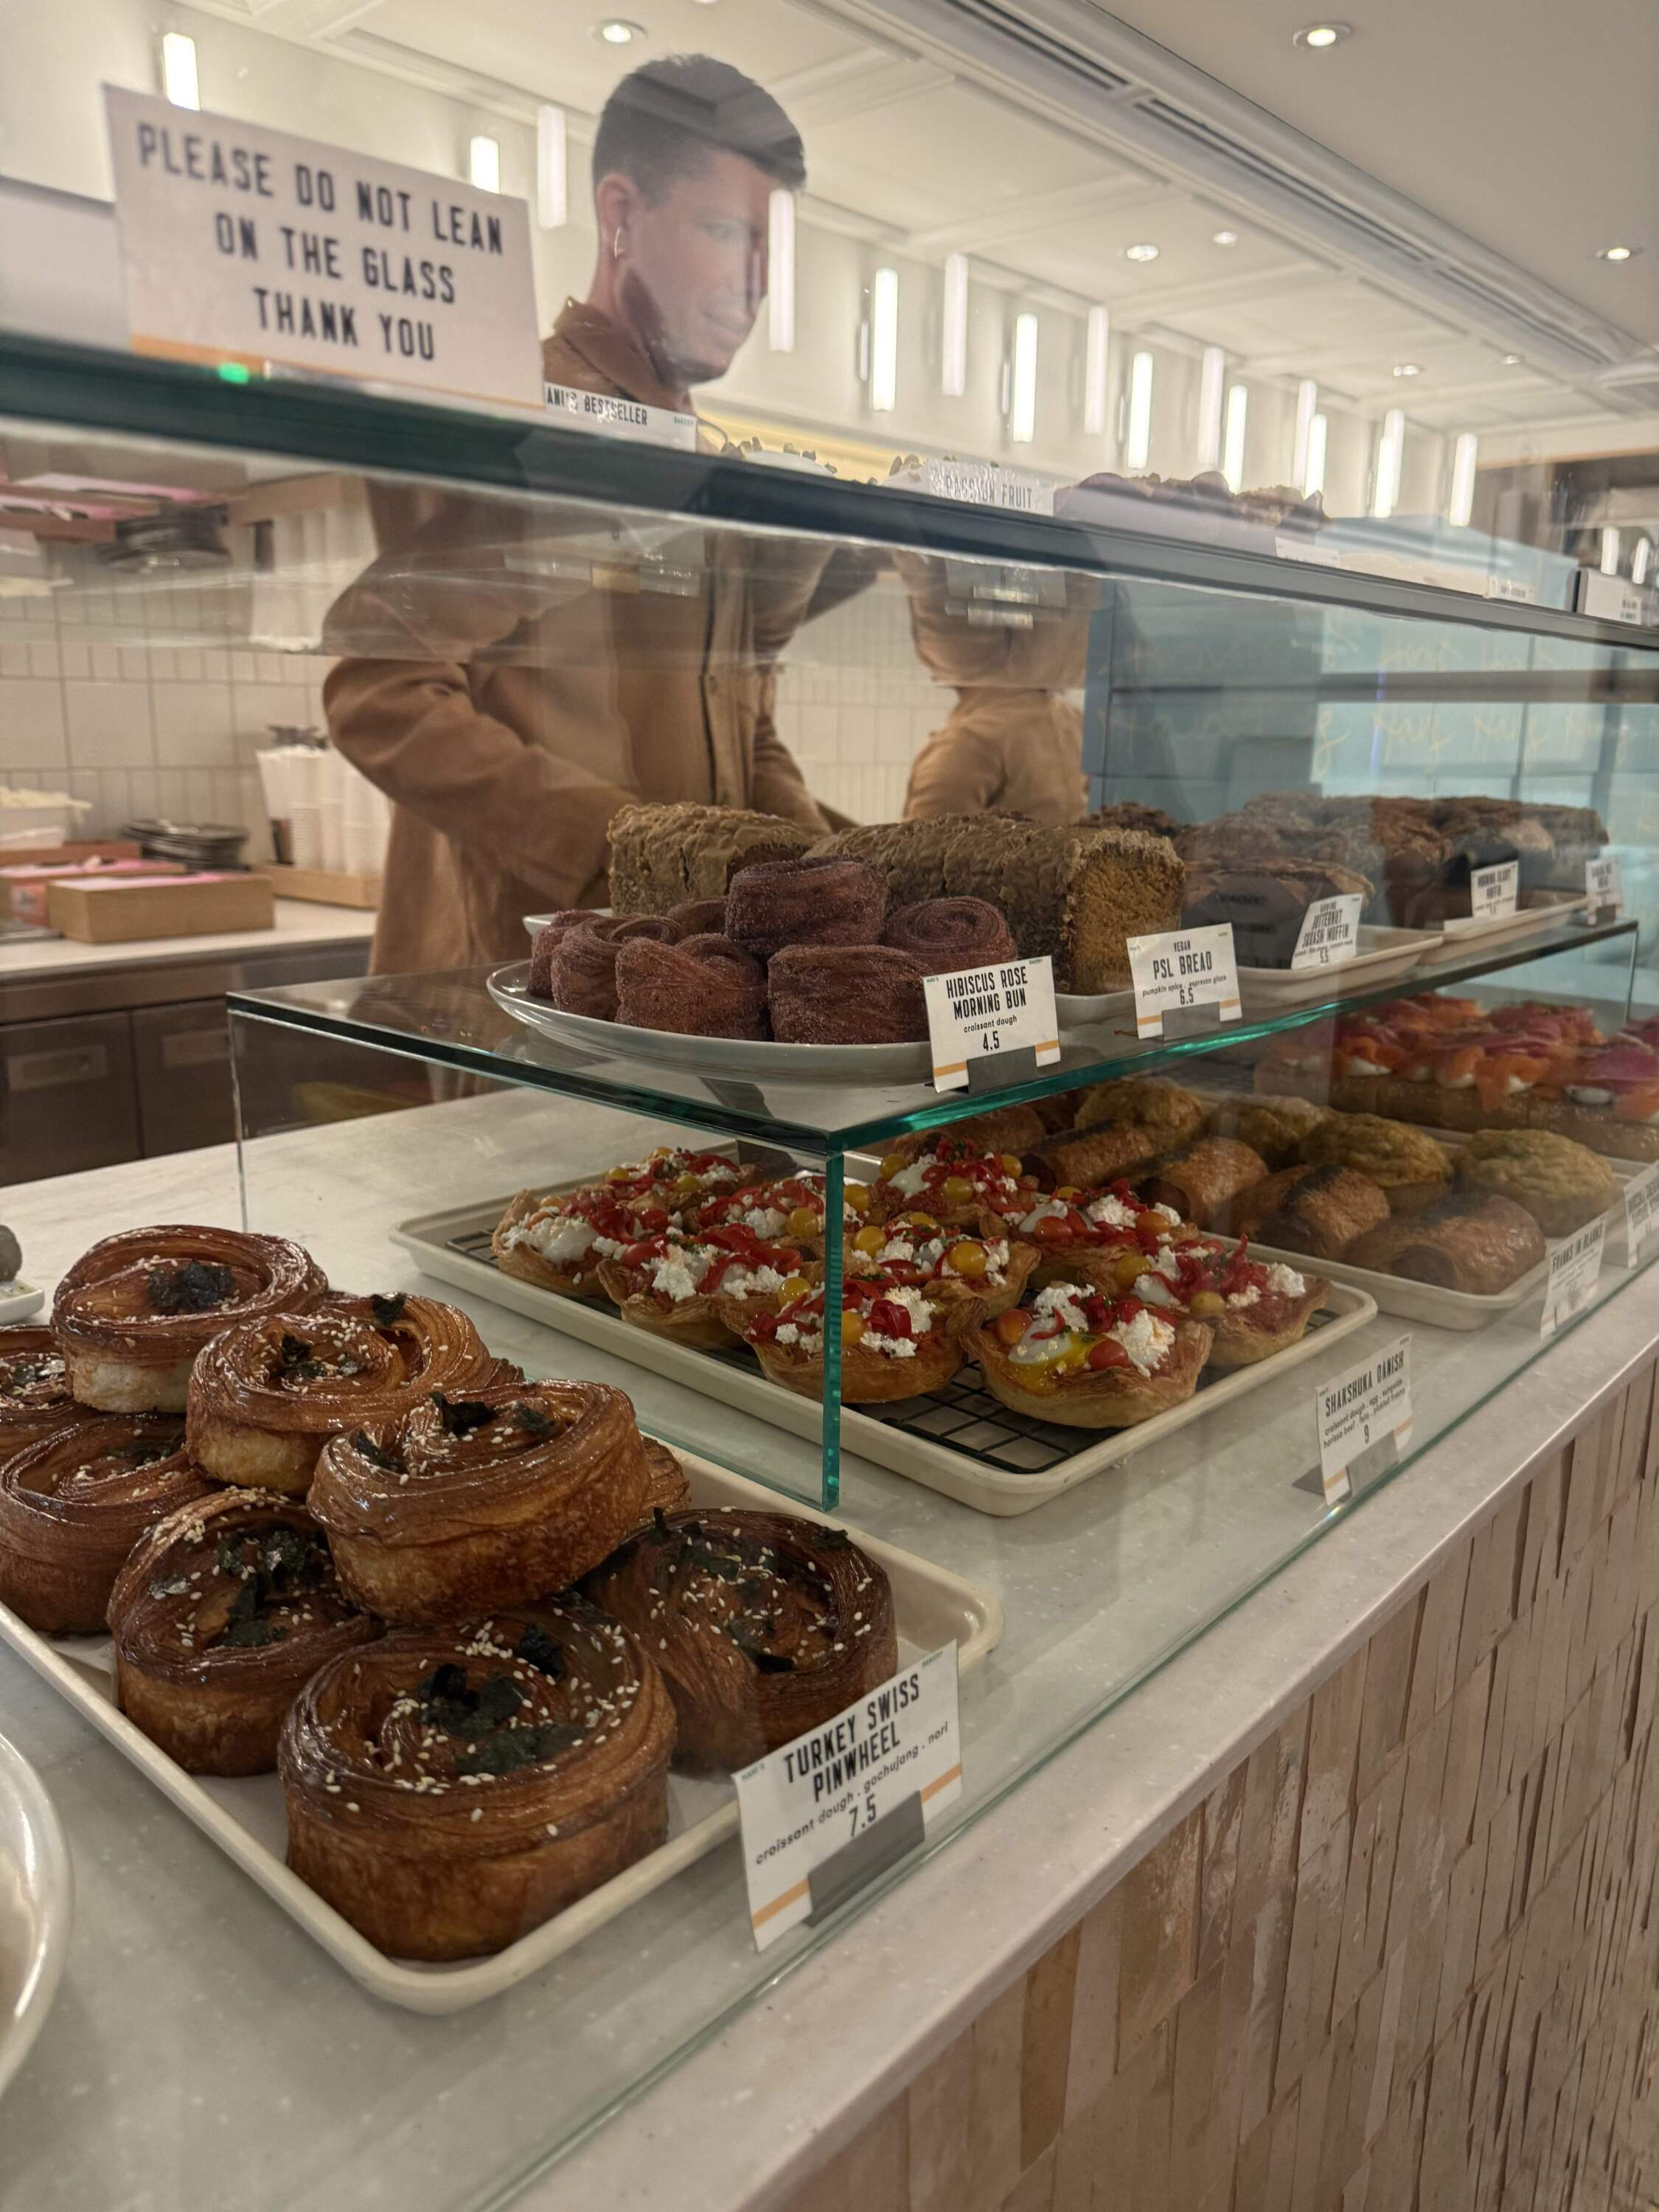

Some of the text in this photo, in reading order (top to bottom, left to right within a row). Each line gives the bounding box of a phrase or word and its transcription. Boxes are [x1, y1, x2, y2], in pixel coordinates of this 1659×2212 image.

[138, 122, 502, 254] PLEASE DO NOT LEAN
[217, 213, 454, 304] ON THE GLASS
[254, 287, 434, 361] THANK YOU
[585, 395, 647, 425] BESTSELLER
[1002, 483, 1032, 509] FRUIT
[1174, 940, 1191, 952] VEGAN
[1302, 928, 1324, 947] SQUASH
[1327, 924, 1349, 942] MUFFIN
[1153, 951, 1213, 980] PSL BREAD
[946, 966, 1028, 998] HIBISCUS ROSE
[1143, 974, 1227, 998] pumpkin spice espresso glaze
[1180, 987, 1194, 1005] 6.5
[953, 988, 1026, 1020] MORNING BUN
[964, 1015, 1018, 1033] croissant dough
[983, 1031, 1000, 1051] 4.5
[1326, 1350, 1404, 1417] SHAKSHUKA DANISH
[1324, 1413, 1349, 1436] croissant
[1349, 1403, 1366, 1419] dough
[1364, 1424, 1369, 1444] 9
[784, 1674, 920, 1784] TURKEY SWISS
[813, 1721, 901, 1803] PINWHEEL
[756, 1722, 949, 1865] croissant dough gochujang nori
[849, 1793, 877, 1837] 7.5
